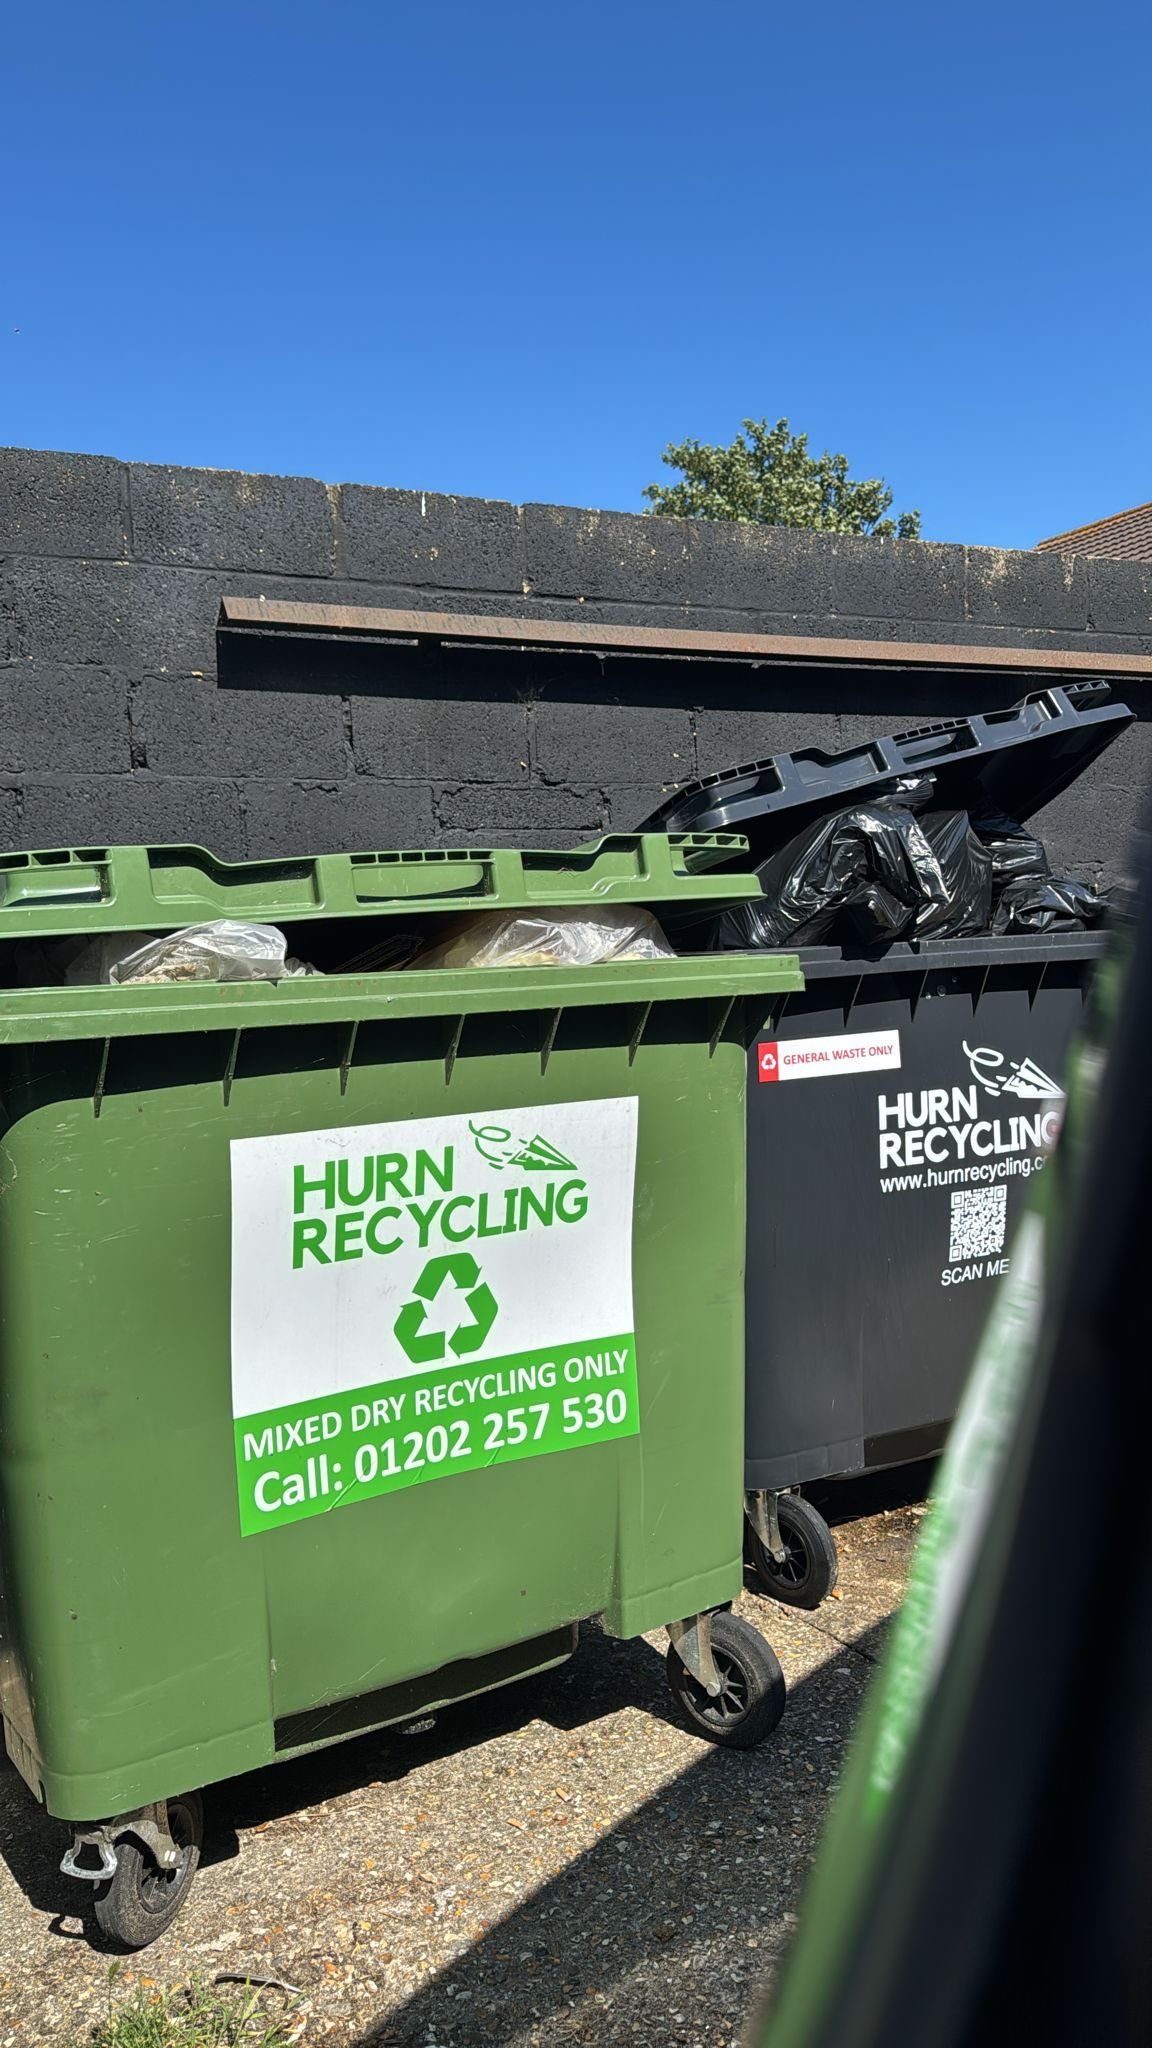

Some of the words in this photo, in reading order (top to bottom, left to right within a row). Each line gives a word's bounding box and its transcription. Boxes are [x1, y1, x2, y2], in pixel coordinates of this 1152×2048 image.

[783, 1052, 830, 1065] GENERAL
[832, 1047, 866, 1060] WASTE
[868, 1045, 893, 1056] ONLY
[878, 1085, 977, 1131] HURN
[293, 1146, 454, 1214] HURN
[292, 1179, 588, 1269] RECYCLING
[941, 1263, 983, 1286] SCAN
[986, 1258, 1010, 1277] ME
[243, 1411, 342, 1461] MIXED
[351, 1394, 406, 1431] DRY
[415, 1362, 556, 1416] RECYCLING
[563, 1349, 628, 1384] ONLY
[253, 1456, 343, 1512] Call:
[354, 1420, 472, 1484] 01202
[483, 1403, 551, 1450] 257
[563, 1388, 627, 1434] 530
